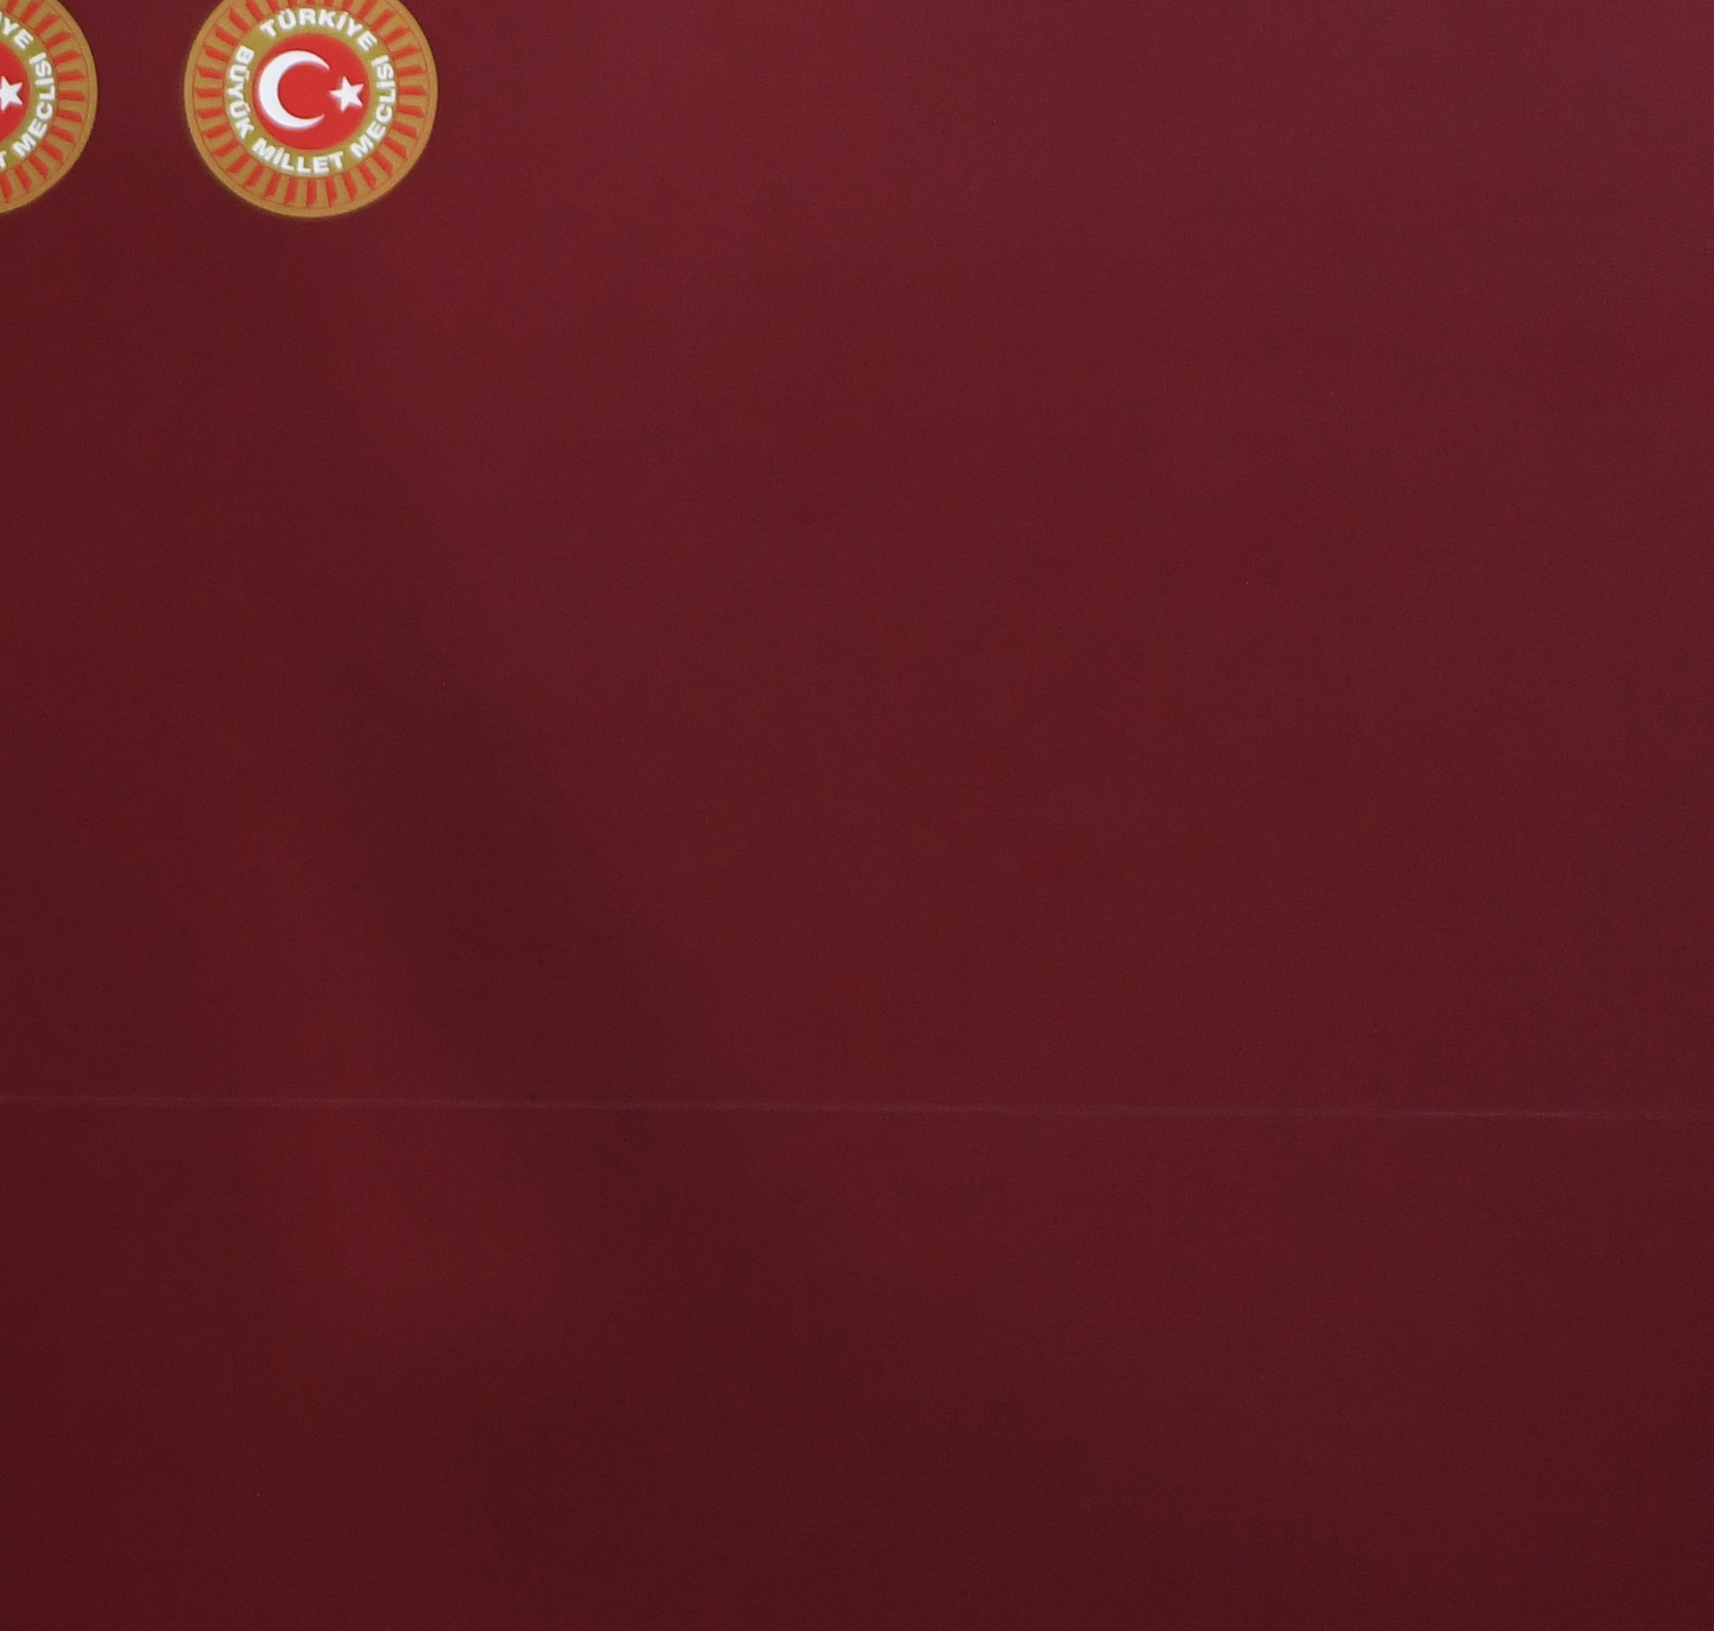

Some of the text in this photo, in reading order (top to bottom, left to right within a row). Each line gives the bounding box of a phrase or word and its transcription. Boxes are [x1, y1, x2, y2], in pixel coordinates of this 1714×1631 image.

[259, 8, 378, 53] TÜRKİYE
[226, 45, 255, 140] BÜYÜK
[251, 138, 344, 176] MİLLET
